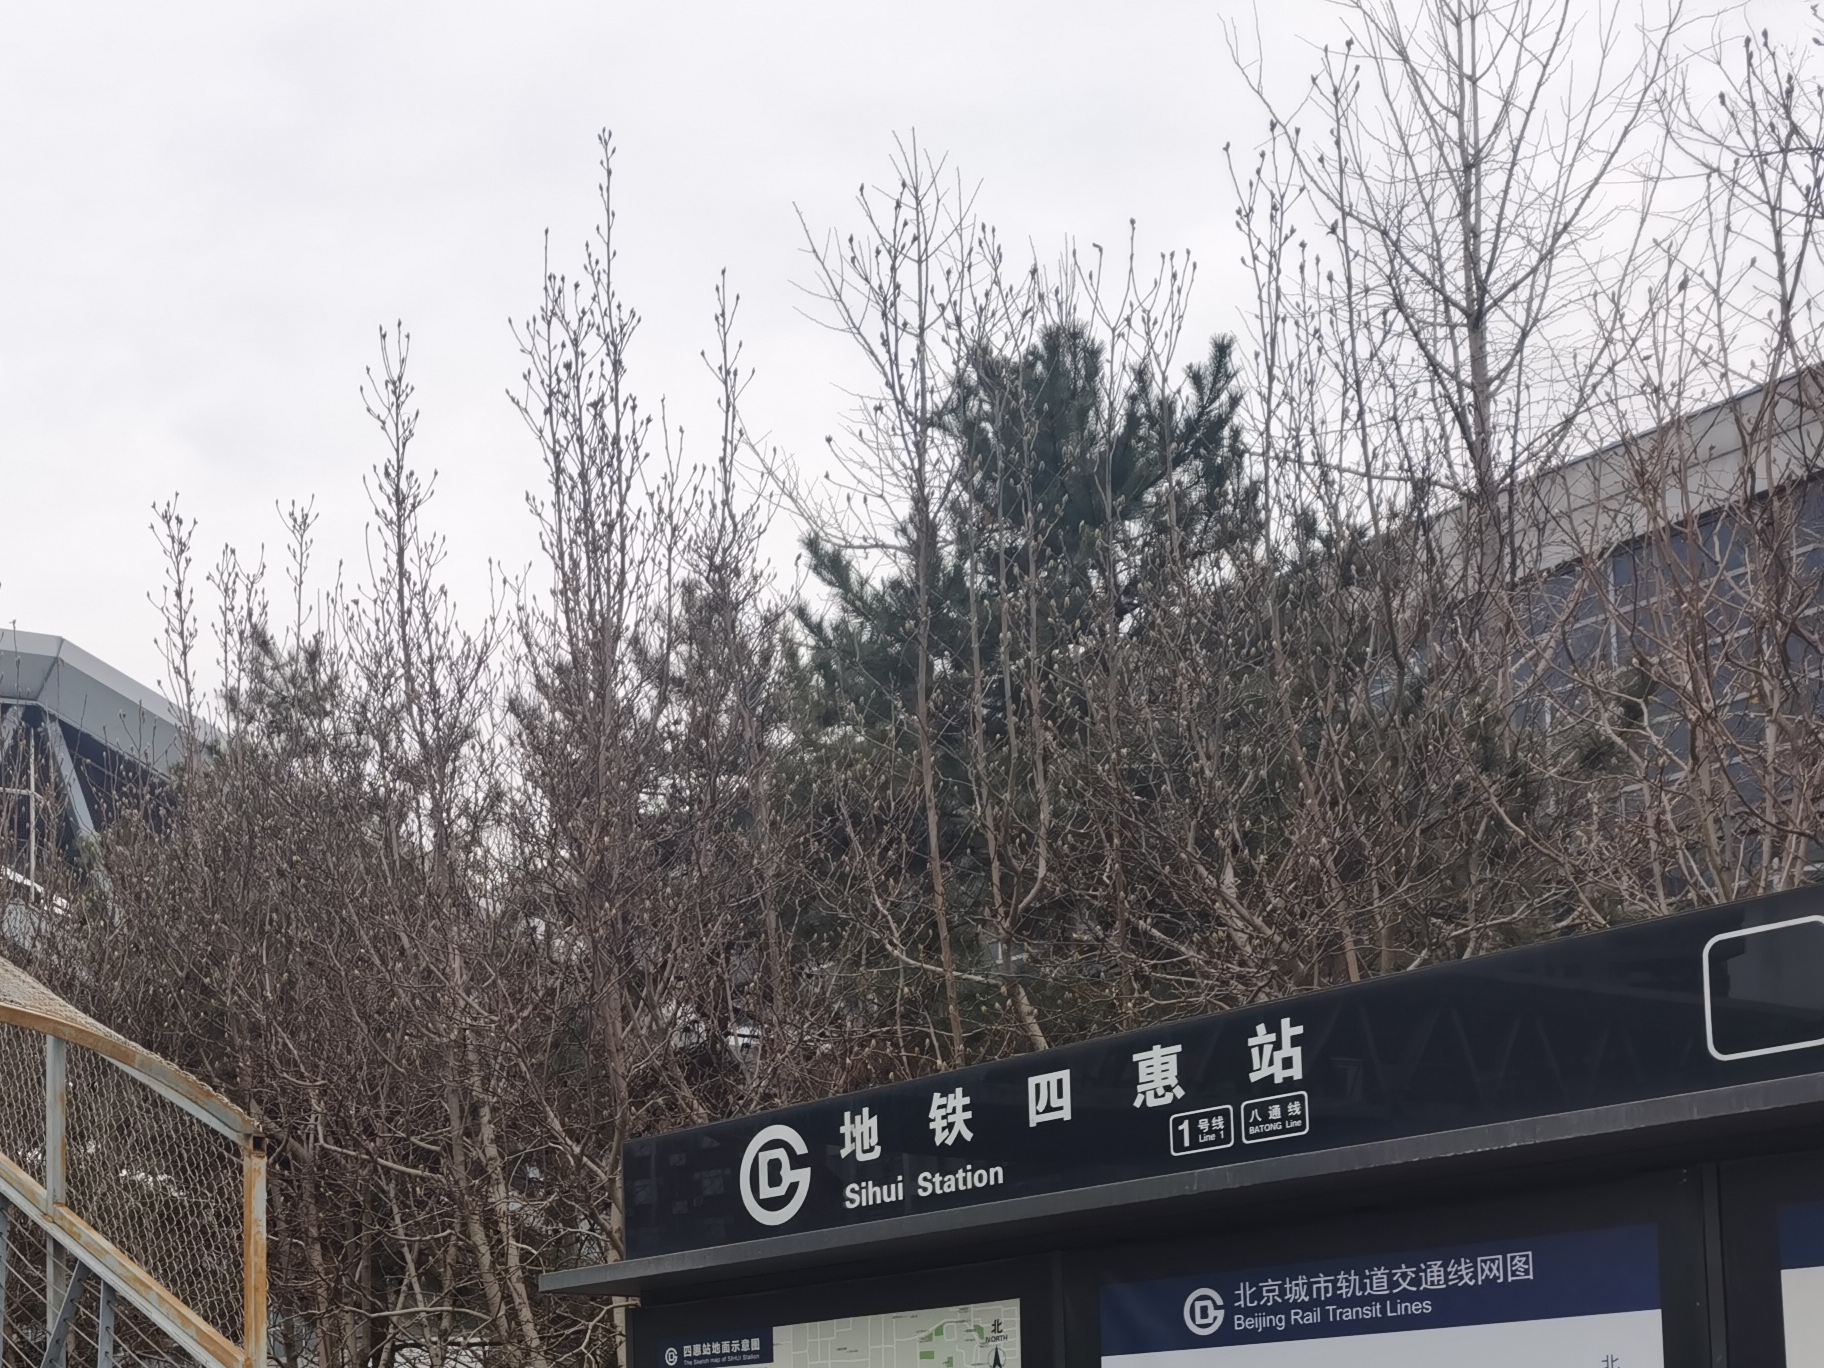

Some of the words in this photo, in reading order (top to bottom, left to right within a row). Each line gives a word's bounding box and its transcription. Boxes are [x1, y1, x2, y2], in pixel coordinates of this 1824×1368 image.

[839, 1017, 1304, 1162] 地铁四惠站
[1248, 1101, 1302, 1123] 八通线
[1198, 1131, 1217, 1144] Line
[1219, 1130, 1225, 1140] 1
[1249, 1121, 1283, 1135] BATONG
[1285, 1118, 1303, 1129] Line
[844, 1175, 904, 1209] Sihui
[917, 1164, 1004, 1198] Station
[1234, 1251, 1534, 1308] 北京城市轨道交通线网图
[1234, 1309, 1286, 1332] Beijing
[1291, 1307, 1321, 1326] Rail
[1325, 1302, 1382, 1322] Transit
[1386, 1298, 1433, 1317] Lines
[990, 1319, 1003, 1334] 北
[683, 1337, 760, 1358] 四惠站地面示意图
[985, 1335, 1008, 1343] NORTH
